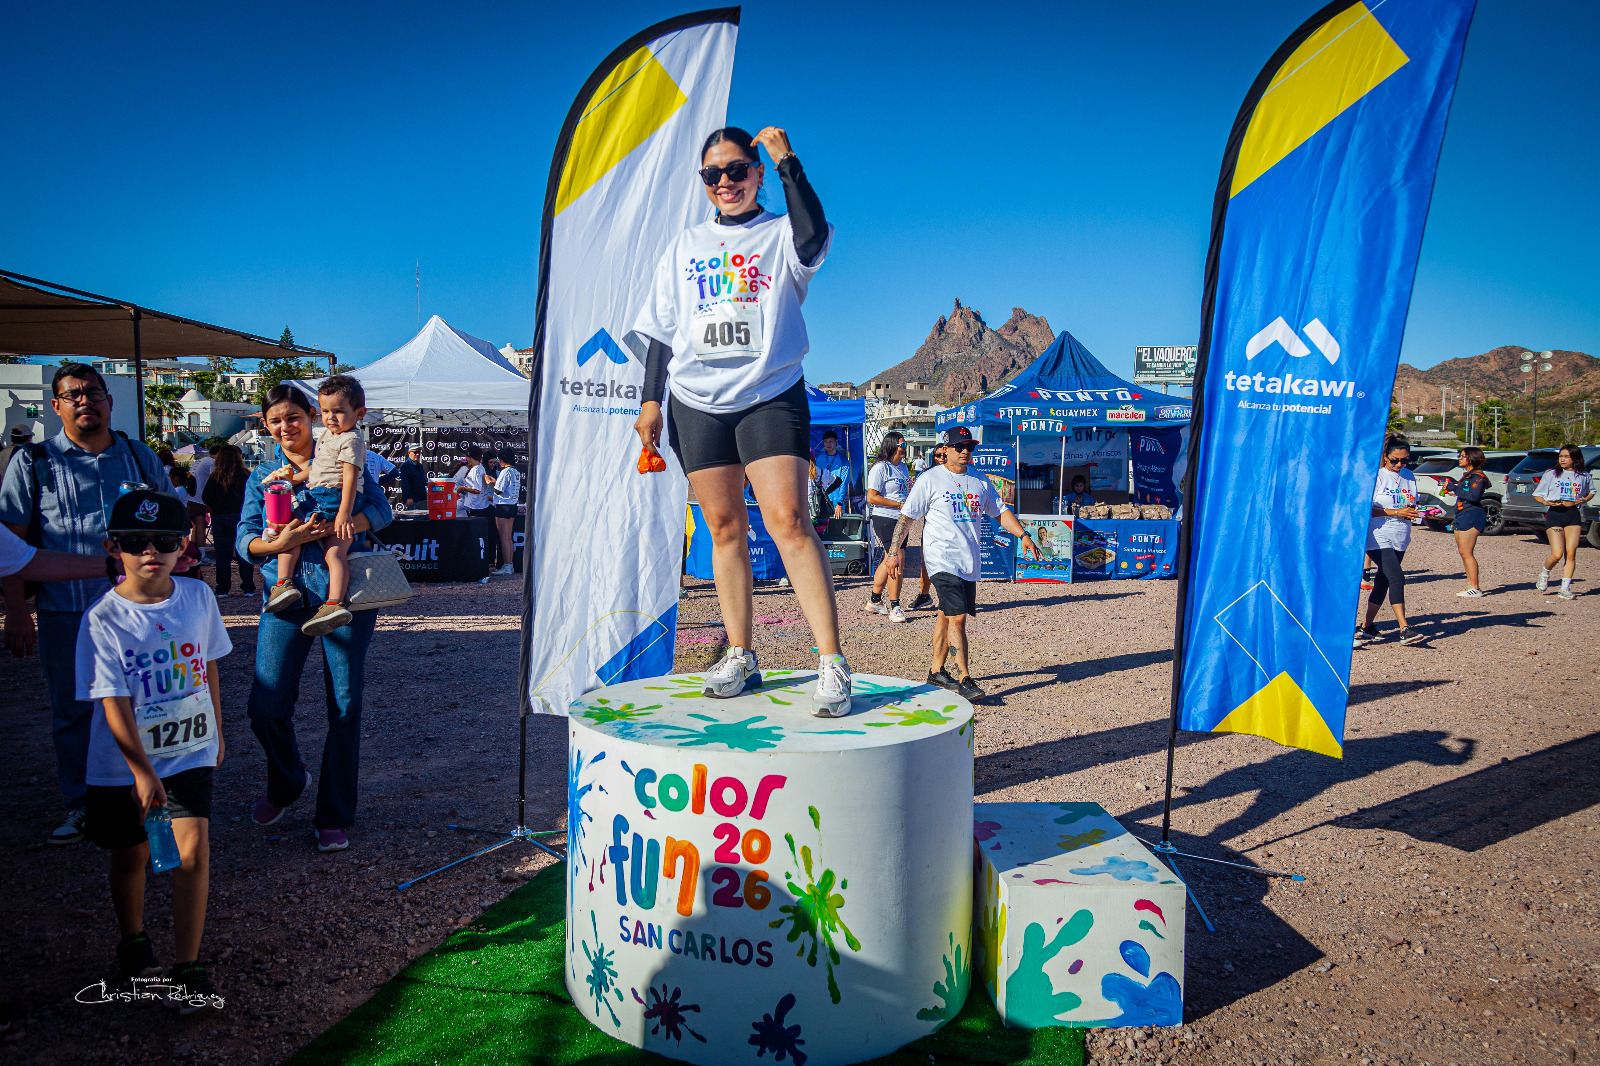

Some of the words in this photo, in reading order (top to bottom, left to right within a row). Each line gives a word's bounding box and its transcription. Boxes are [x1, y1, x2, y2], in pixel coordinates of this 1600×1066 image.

[695, 251, 760, 272] color
[738, 266, 759, 279] 20
[697, 271, 735, 299] fun
[738, 280, 759, 292] 26
[703, 321, 751, 347] 405
[560, 377, 643, 400] tetaka
[1225, 370, 1356, 398] tetakawi
[1037, 389, 1133, 402] PONTO
[573, 404, 600, 413] Alcanza
[601, 406, 608, 414] tu
[609, 407, 642, 415] potenci
[999, 408, 1038, 420] PONTO
[1056, 408, 1099, 417] GUAYMEX
[1238, 400, 1271, 411] Alcanza
[1272, 403, 1281, 411] tu
[1282, 403, 1332, 415] potencial
[1021, 420, 1063, 433] PONTO
[973, 457, 1008, 467] PONTO
[950, 491, 980, 500] color
[952, 501, 969, 513] fun
[1132, 535, 1160, 543] PONTO
[140, 663, 187, 698] fun
[147, 713, 207, 749] 1278
[634, 763, 788, 820] color
[713, 822, 772, 864] 20
[608, 814, 701, 917] fun
[711, 867, 772, 911] 26
[619, 916, 663, 950] SAN
[668, 929, 774, 968] CARLOS
